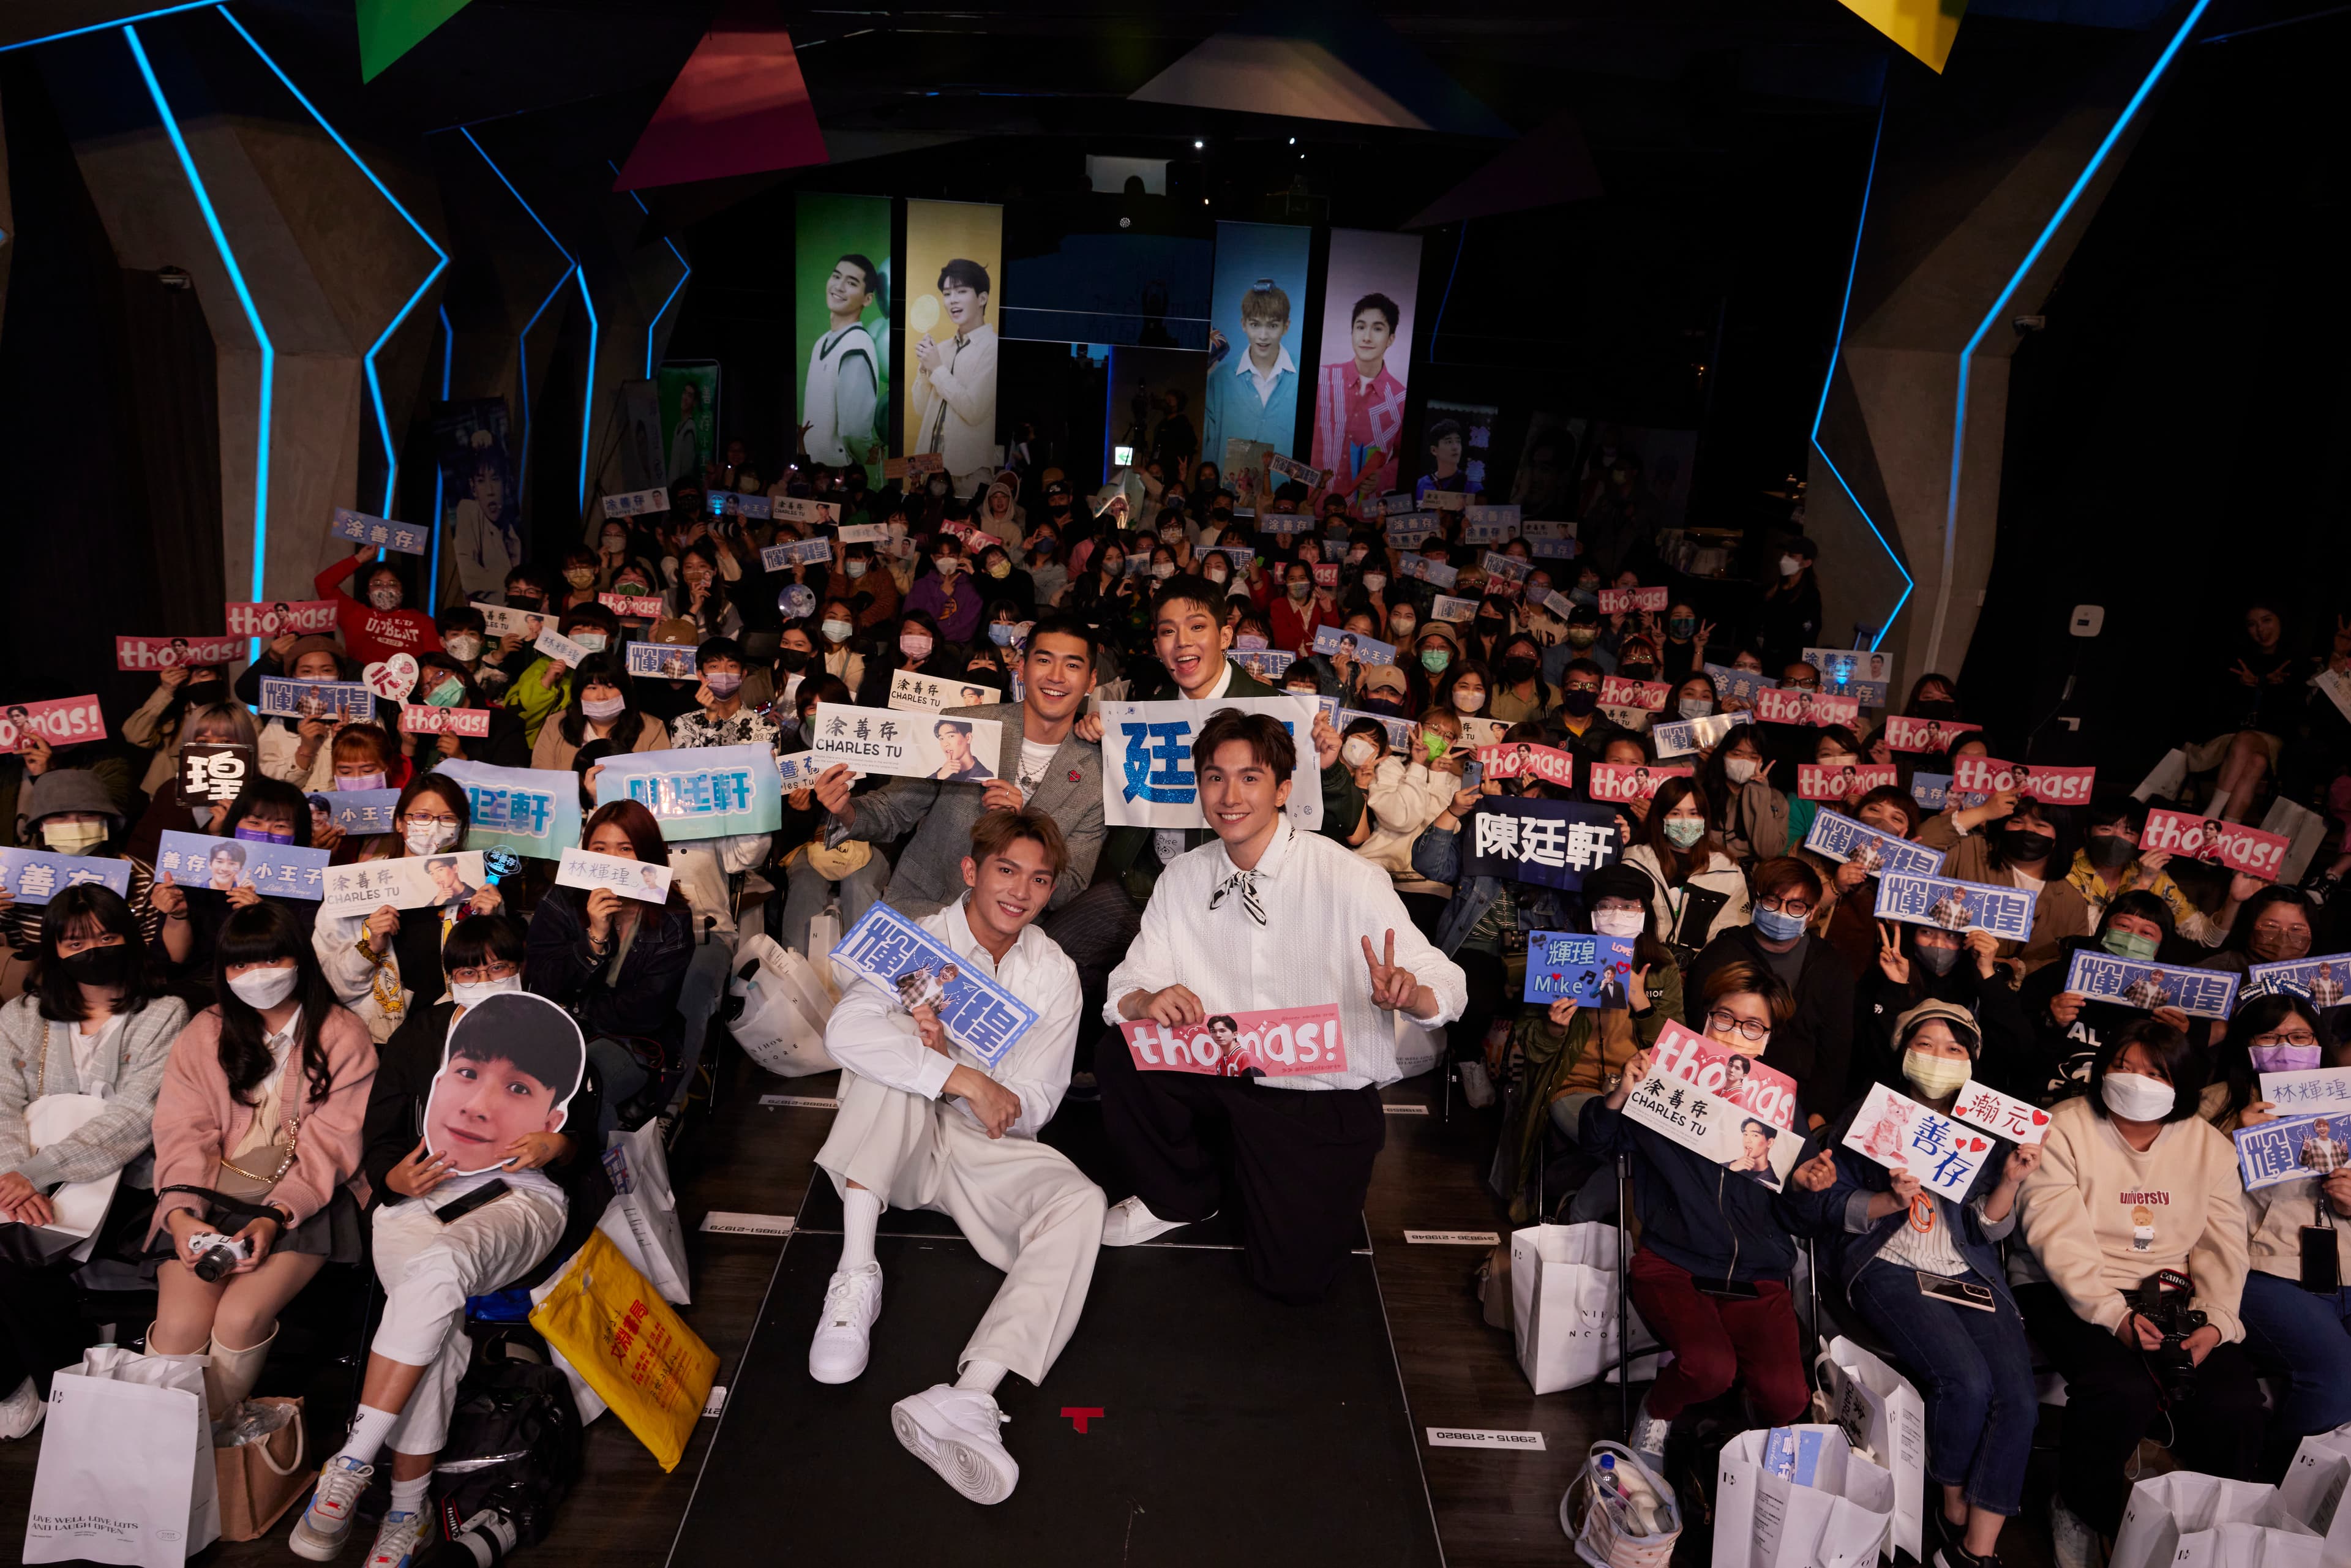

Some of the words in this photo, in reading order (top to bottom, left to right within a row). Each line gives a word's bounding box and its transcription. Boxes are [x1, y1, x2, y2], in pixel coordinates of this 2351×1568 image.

[345, 517, 415, 549] 涂善存
[229, 602, 336, 635] thomas!
[119, 639, 244, 669] thomas!
[1316, 634, 1338, 649] 善存
[1360, 647, 1393, 665] 小王子
[891, 691, 928, 705] CHARLES
[931, 698, 941, 707] TU
[897, 677, 939, 697] 涂善存
[405, 707, 487, 733] thomas!
[1760, 692, 1857, 725] thomas!
[826, 715, 898, 741] 涂善存
[816, 738, 880, 757] CHARLES
[885, 745, 902, 759] TU
[185, 750, 246, 801] 瑝
[1957, 759, 2091, 800] thomas!
[1475, 812, 1615, 872] 陳廷軒
[2146, 813, 2285, 872] thomas!
[161, 850, 207, 874] 善存
[254, 862, 323, 886] 小王子
[568, 860, 631, 887] 林輝瑝
[332, 866, 394, 891] 涂善存
[327, 889, 381, 906] CHARLES
[386, 885, 400, 898] TU
[1546, 939, 1596, 967] 輝瑝
[1611, 942, 1633, 958] LOVE
[1534, 973, 1584, 995] Mike
[1132, 1019, 1338, 1067] thomas!
[1643, 1077, 1708, 1120] 涂善存
[2272, 1078, 2350, 1103] 林輝瑝
[1631, 1091, 1687, 1127] CHARLES
[1690, 1120, 1707, 1136] TU
[1968, 1092, 2031, 1136] 瀚元
[1911, 1116, 1975, 1188] 善存
[1436, 1431, 1485, 1442] 219820
[1498, 1433, 1537, 1444] 29815
[31, 1523, 51, 1531] AND
[54, 1522, 91, 1531] LAUGH
[94, 1523, 124, 1535] OFTEN
[32, 1514, 51, 1524] LIVE
[88, 1515, 111, 1526] LOVE
[113, 1520, 139, 1529] LOTS
